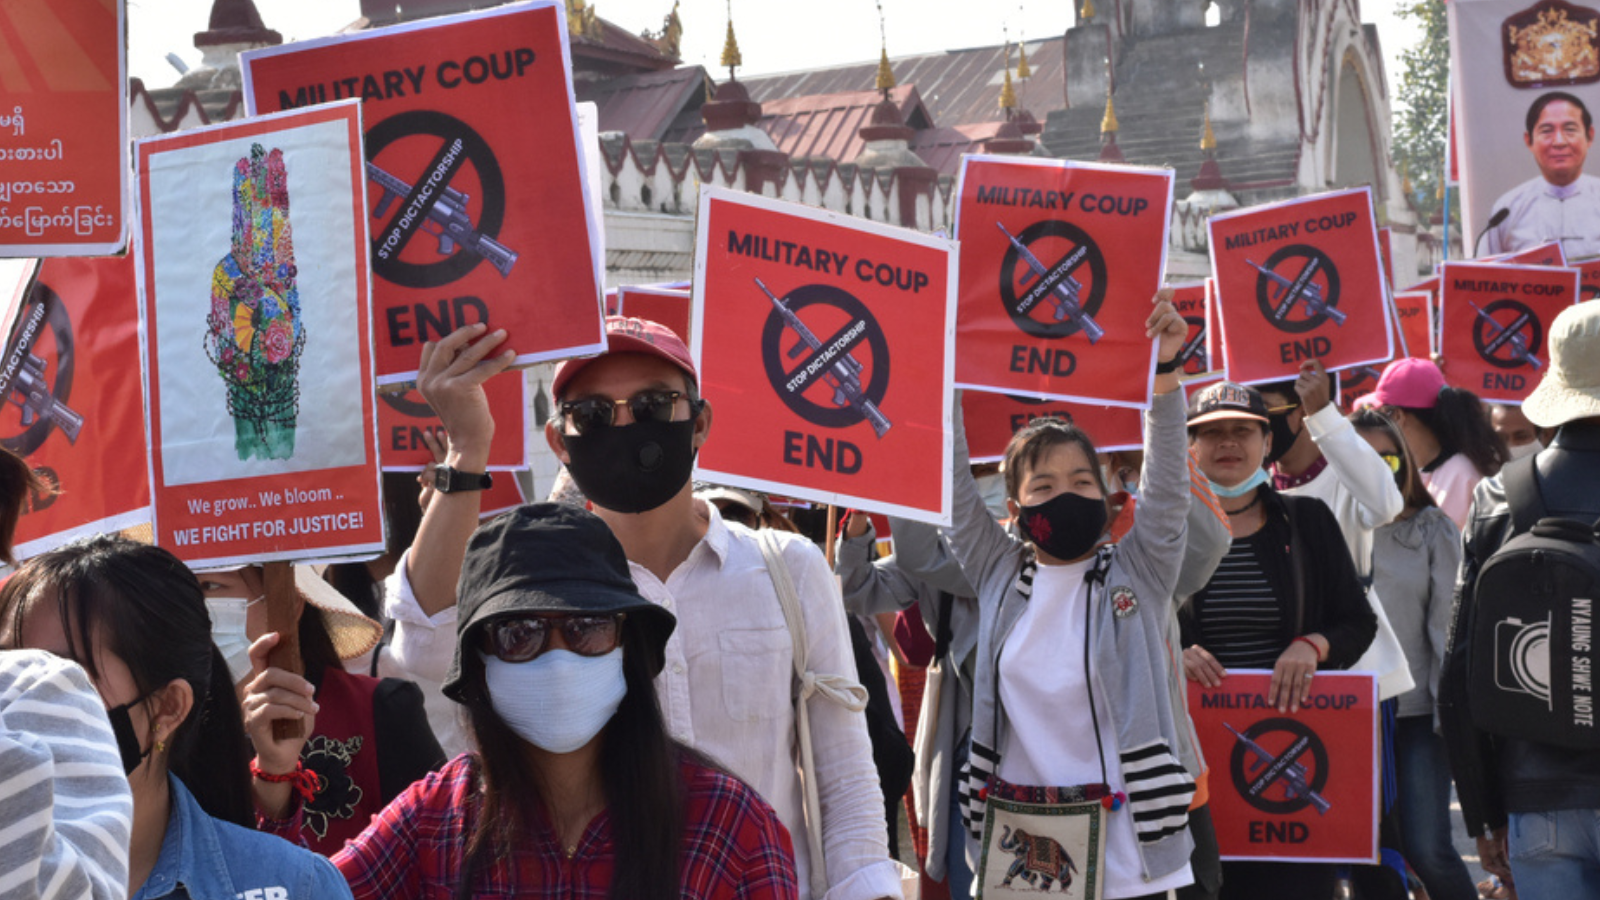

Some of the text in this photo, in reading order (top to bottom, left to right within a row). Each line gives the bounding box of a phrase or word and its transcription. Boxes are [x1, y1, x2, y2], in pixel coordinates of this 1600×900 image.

[278, 48, 535, 110] MILITARY COUP
[378, 138, 463, 259] STOP DICTACTORSHIP
[977, 185, 1148, 217] MILITARY COUP
[1225, 212, 1357, 250] MILITARY COUP
[728, 230, 929, 293] MILITARY COUP
[1016, 294, 1033, 313] STOP
[1454, 279, 1518, 294] MILITARY
[1522, 283, 1565, 296] COUP
[386, 296, 489, 347] END
[1398, 307, 1420, 317] OUP
[0, 302, 45, 394] CTACTORSHIP
[786, 320, 866, 392] STOP DICTACTORSHIP
[1009, 345, 1077, 378] END
[1279, 336, 1331, 364] END
[1482, 372, 1526, 391] END
[392, 425, 445, 450] EN
[783, 430, 863, 475] END
[187, 499, 211, 515] We
[213, 496, 257, 517] grow..
[259, 492, 282, 508] We
[284, 487, 332, 505] bloom
[173, 511, 365, 547] WE FIGHT FOR JUSTICE!
[1571, 598, 1593, 727] NYAUNG SHWE NOTE
[1201, 693, 1358, 710] MILITA COUP
[1249, 821, 1310, 844] END
